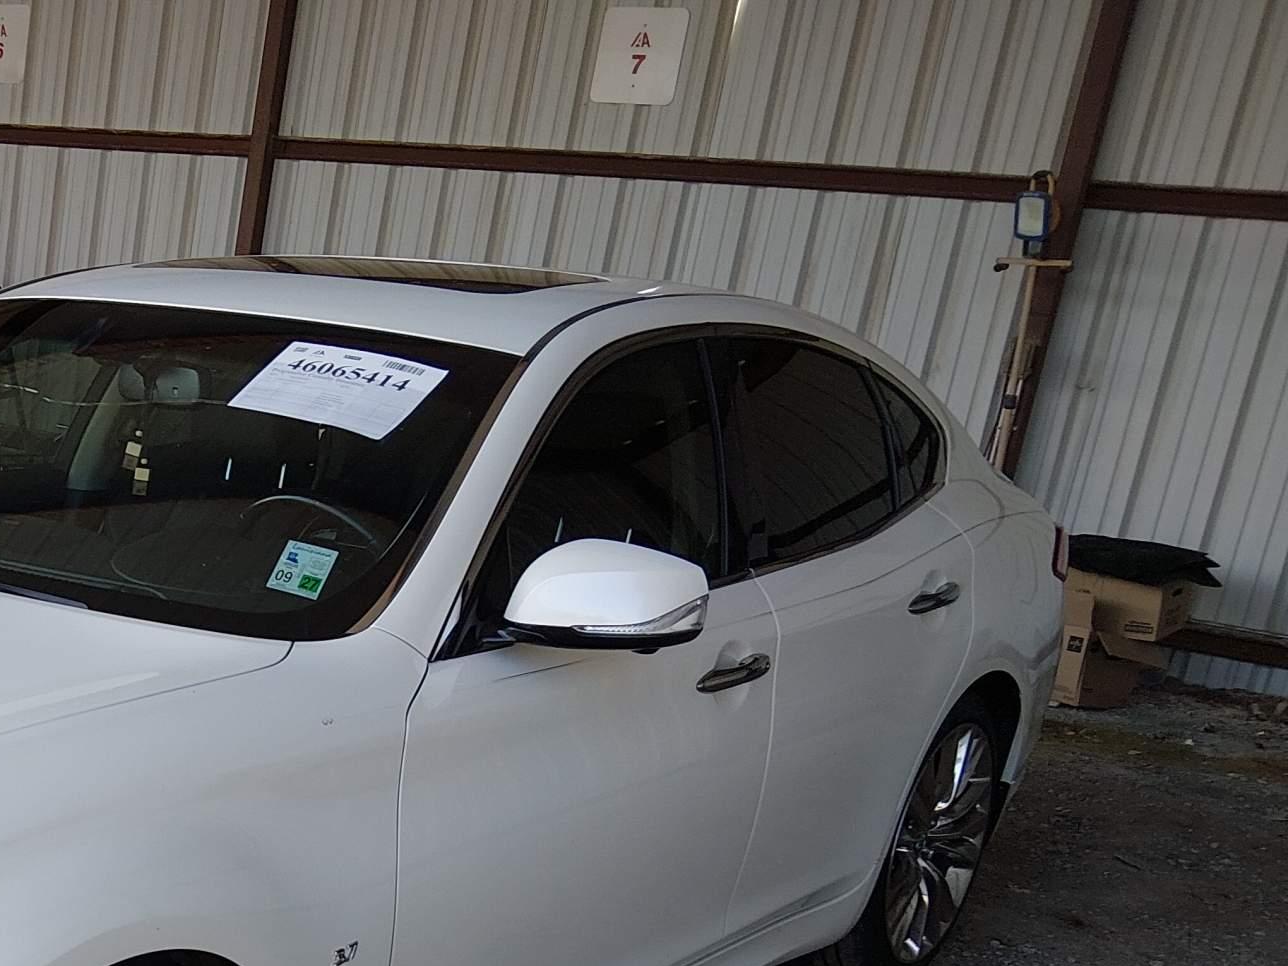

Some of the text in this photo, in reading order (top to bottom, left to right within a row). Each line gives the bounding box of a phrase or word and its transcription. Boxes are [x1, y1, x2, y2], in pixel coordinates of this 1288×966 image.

[632, 54, 646, 74] 7
[286, 357, 411, 392] 46065414
[274, 569, 293, 583] 09
[301, 576, 319, 593] 27
